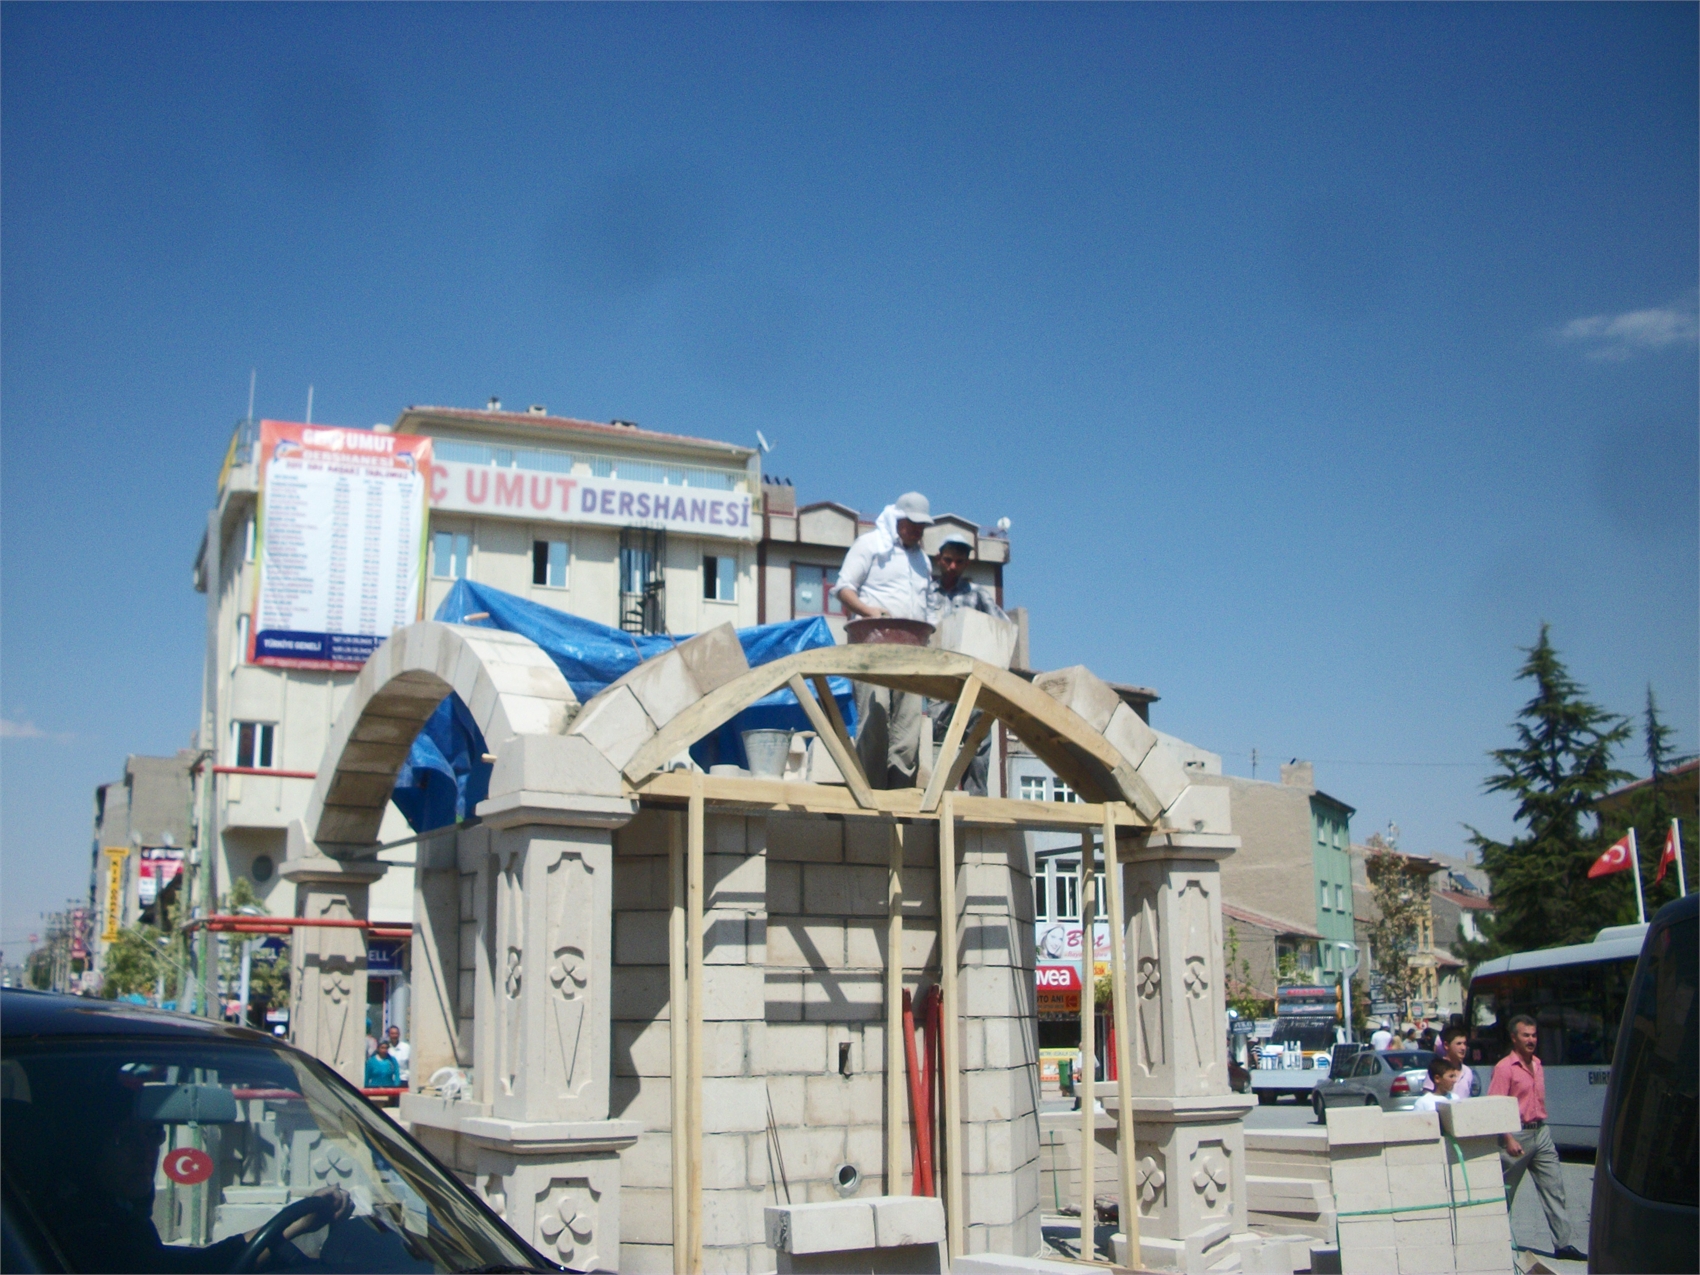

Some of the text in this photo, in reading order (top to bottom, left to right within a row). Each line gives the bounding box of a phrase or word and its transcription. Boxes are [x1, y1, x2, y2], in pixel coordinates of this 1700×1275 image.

[346, 432, 396, 453] UMUT
[465, 468, 577, 512] UMUT
[580, 487, 750, 527] DERSHANESİ
[1037, 995, 1049, 1003] TO
